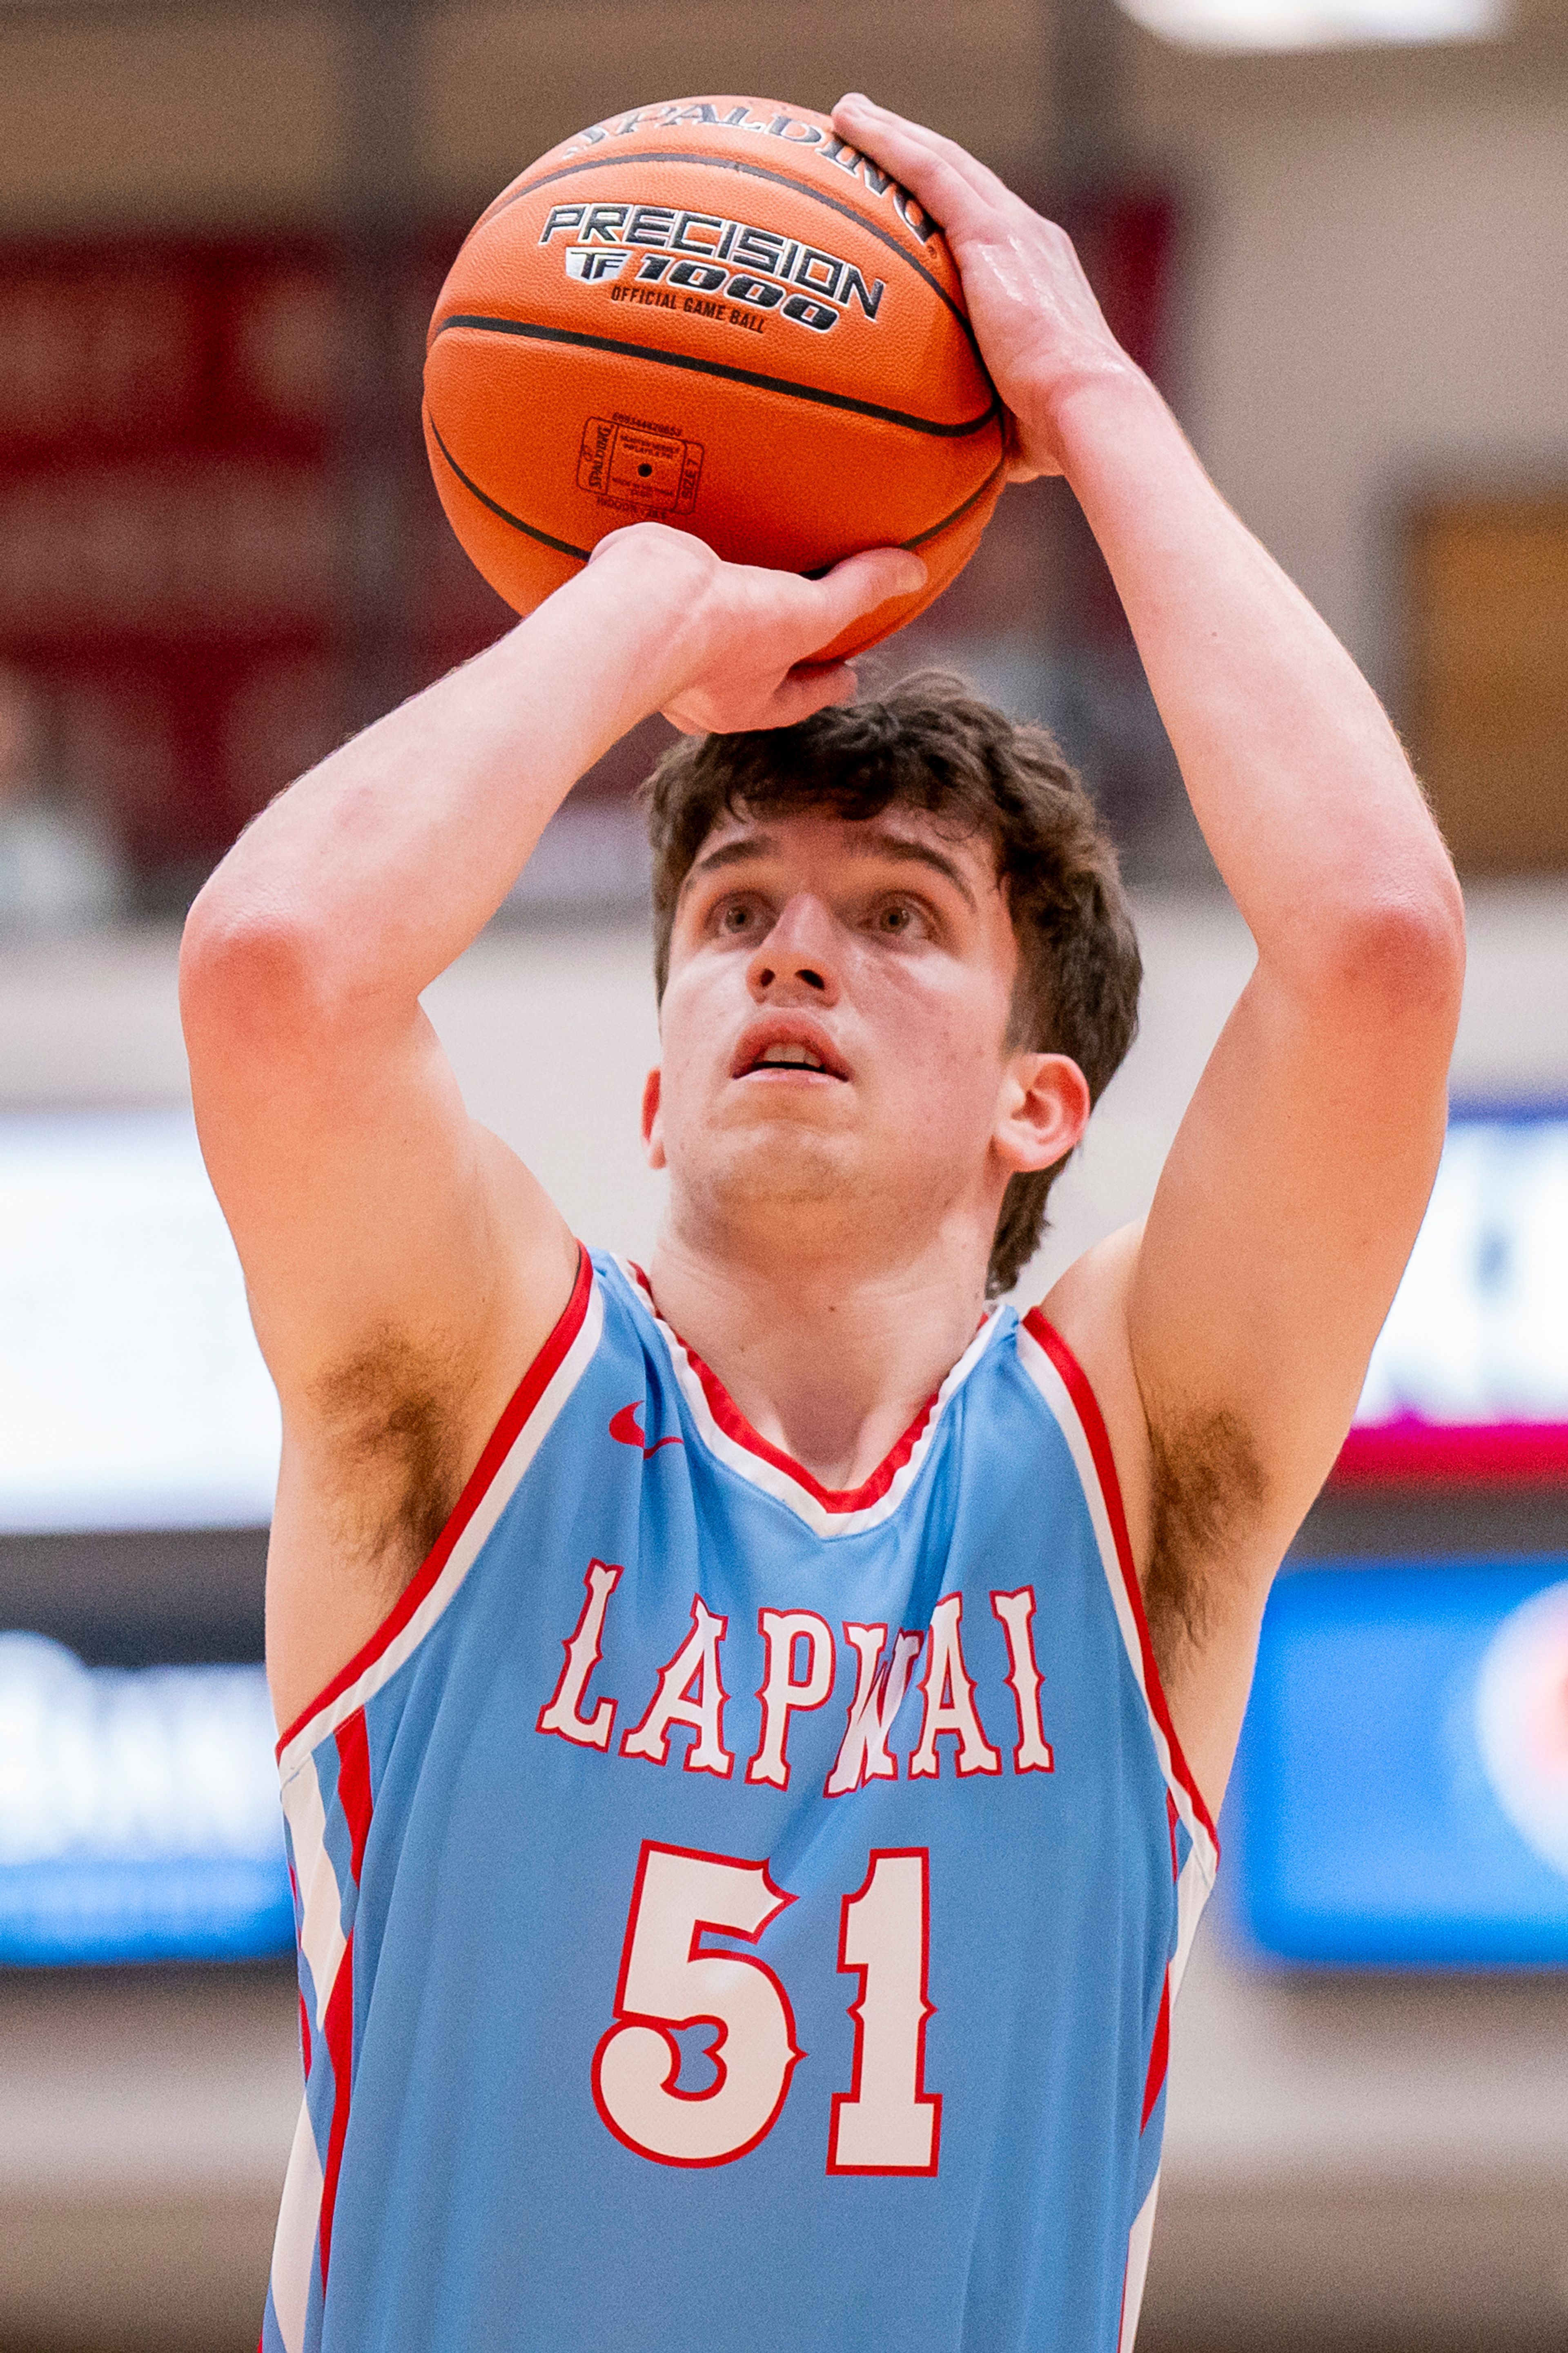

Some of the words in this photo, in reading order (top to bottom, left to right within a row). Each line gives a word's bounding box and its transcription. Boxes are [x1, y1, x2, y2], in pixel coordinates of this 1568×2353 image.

[539, 201, 887, 323] PRECISION
[570, 251, 630, 281] TF
[634, 252, 840, 334] 1000
[611, 285, 677, 310] OFFICIAL
[684, 297, 726, 321] GAME
[729, 309, 766, 334] BALL
[682, 470, 696, 500] SIZE
[686, 458, 698, 466] 7
[536, 1557, 1055, 1798] LAPWAI
[590, 1838, 943, 2177] 51
